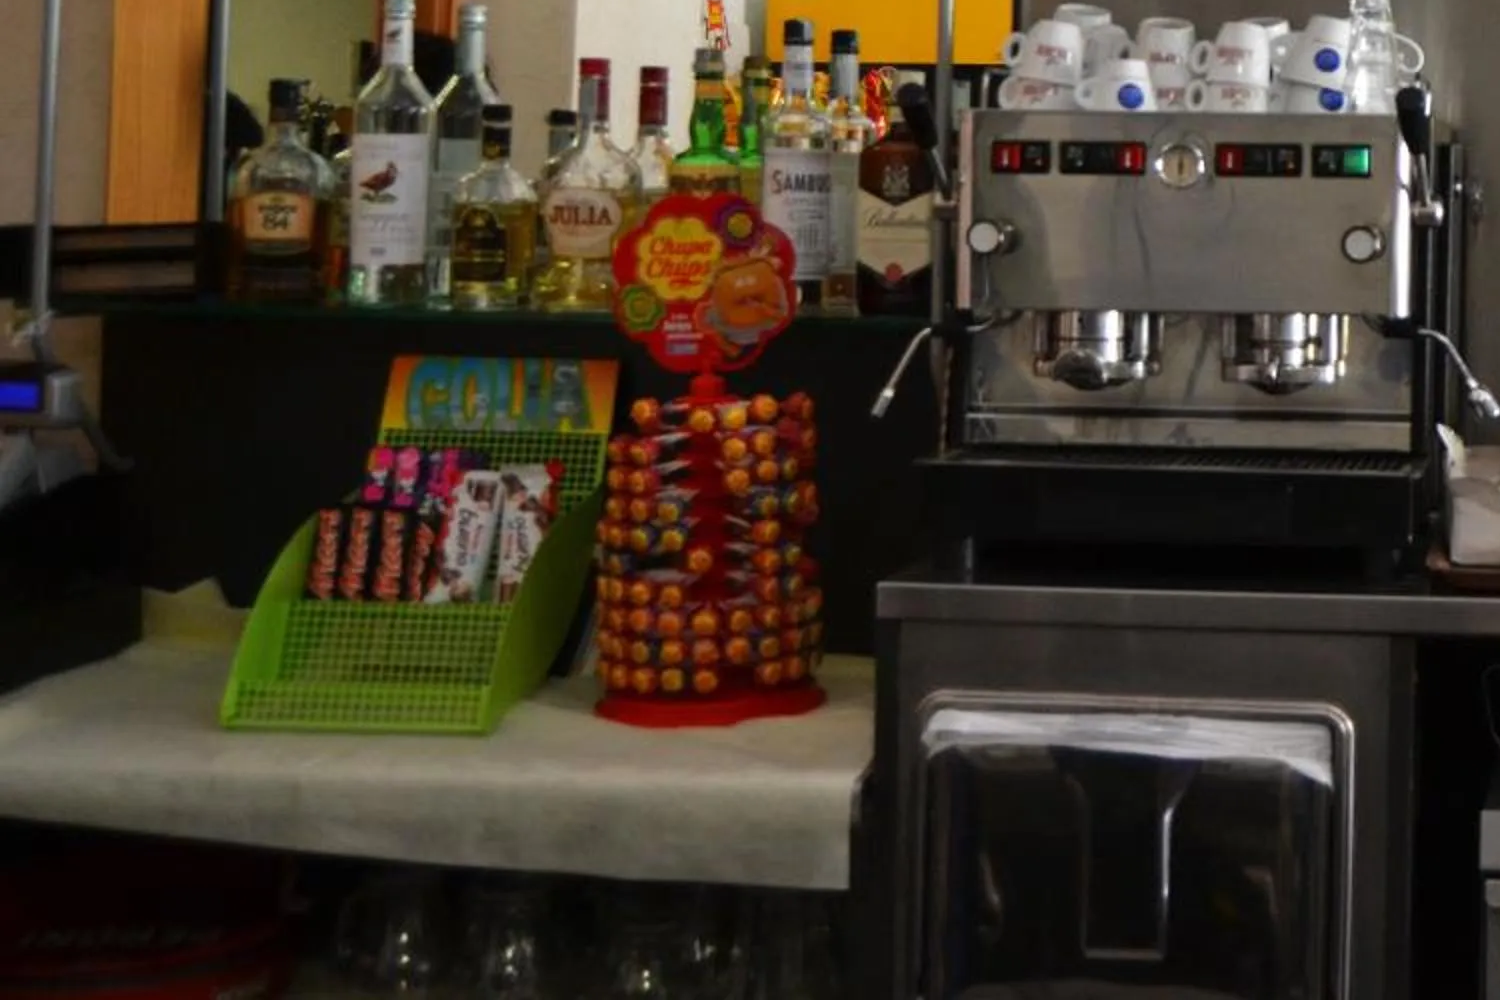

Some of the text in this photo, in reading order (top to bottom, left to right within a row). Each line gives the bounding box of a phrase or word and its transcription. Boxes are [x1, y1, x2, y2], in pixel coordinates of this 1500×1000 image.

[549, 204, 613, 226] JULIA
[650, 236, 713, 255] Chupa
[646, 257, 712, 280] Chups
